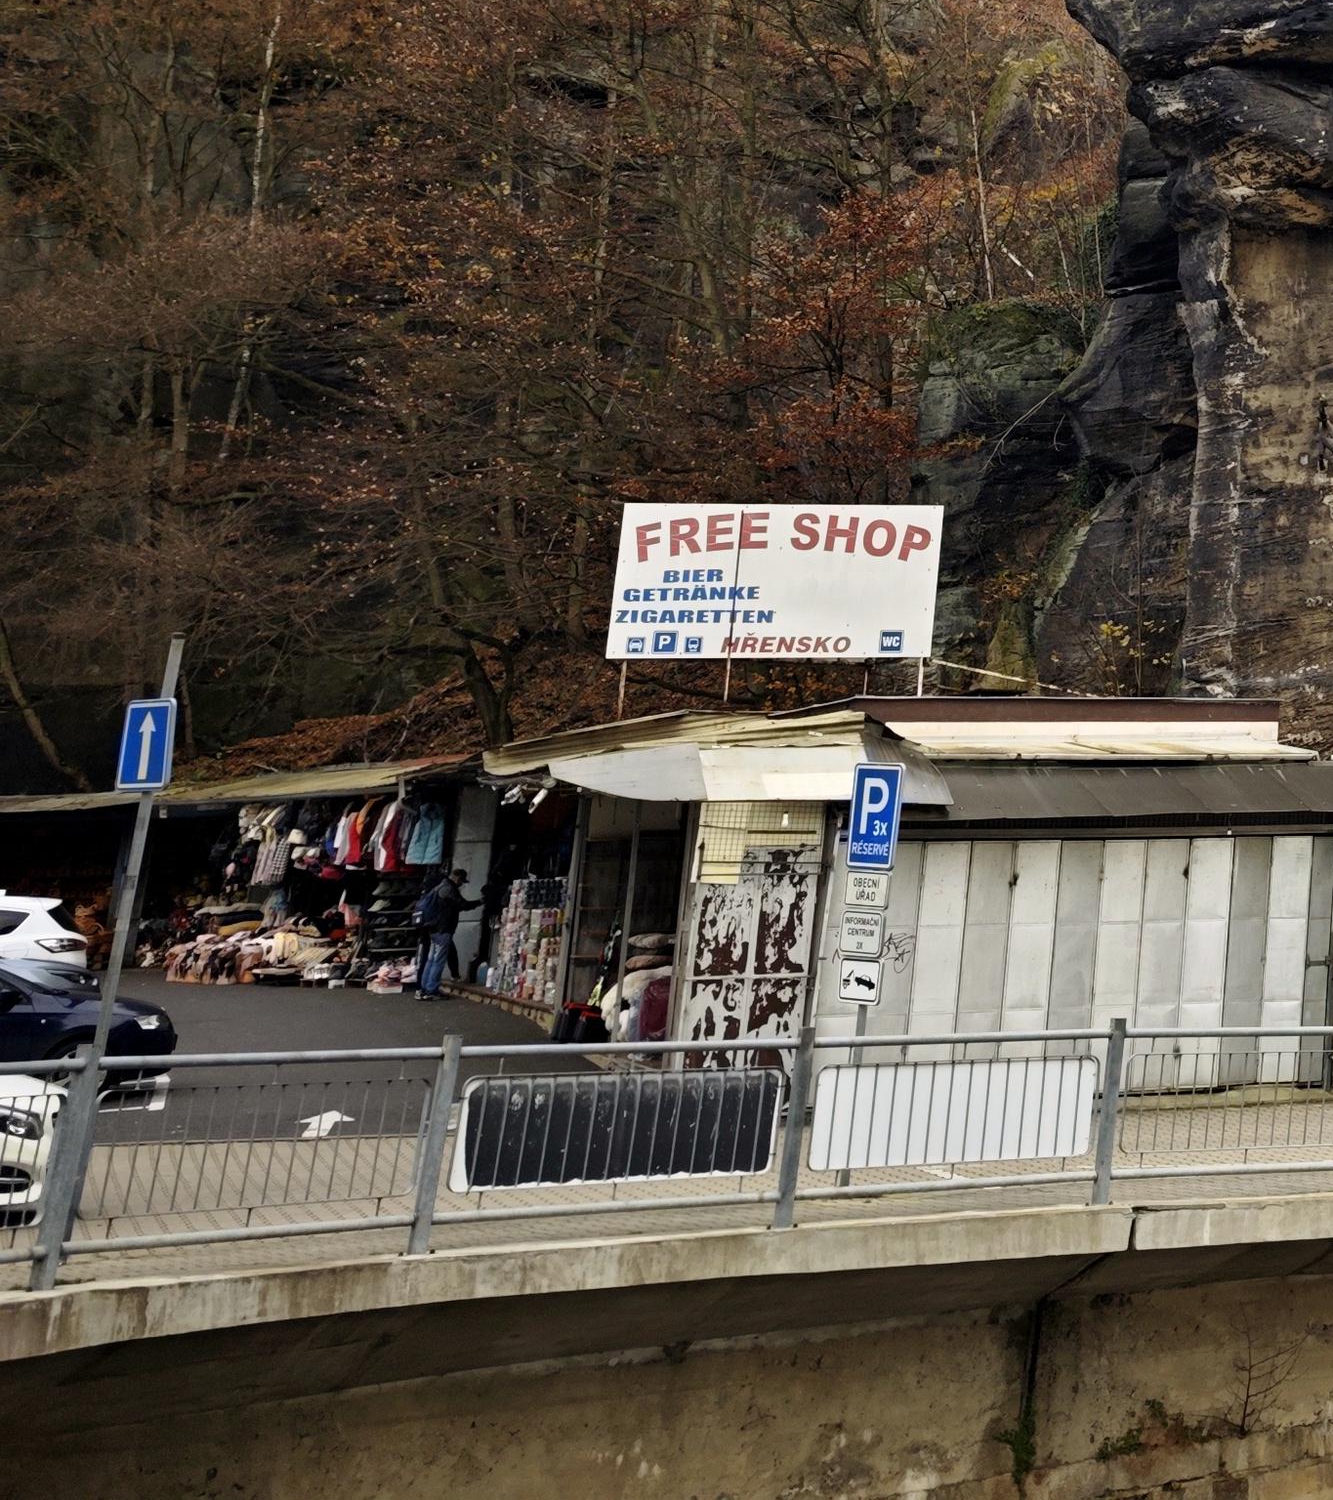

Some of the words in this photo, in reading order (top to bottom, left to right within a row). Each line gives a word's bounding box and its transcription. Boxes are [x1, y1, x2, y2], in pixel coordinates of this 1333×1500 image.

[635, 512, 770, 563] FREE
[790, 513, 932, 562] SHOP
[662, 568, 724, 584] BIER
[622, 583, 761, 601] GETRÄNKE
[615, 609, 774, 624] ZIGARETTEN
[720, 632, 851, 654] HŘENSKO
[882, 634, 901, 648] WC
[859, 777, 890, 835] P
[851, 840, 889, 857] RÉSERVÉ
[847, 927, 875, 937] CENTRUM
